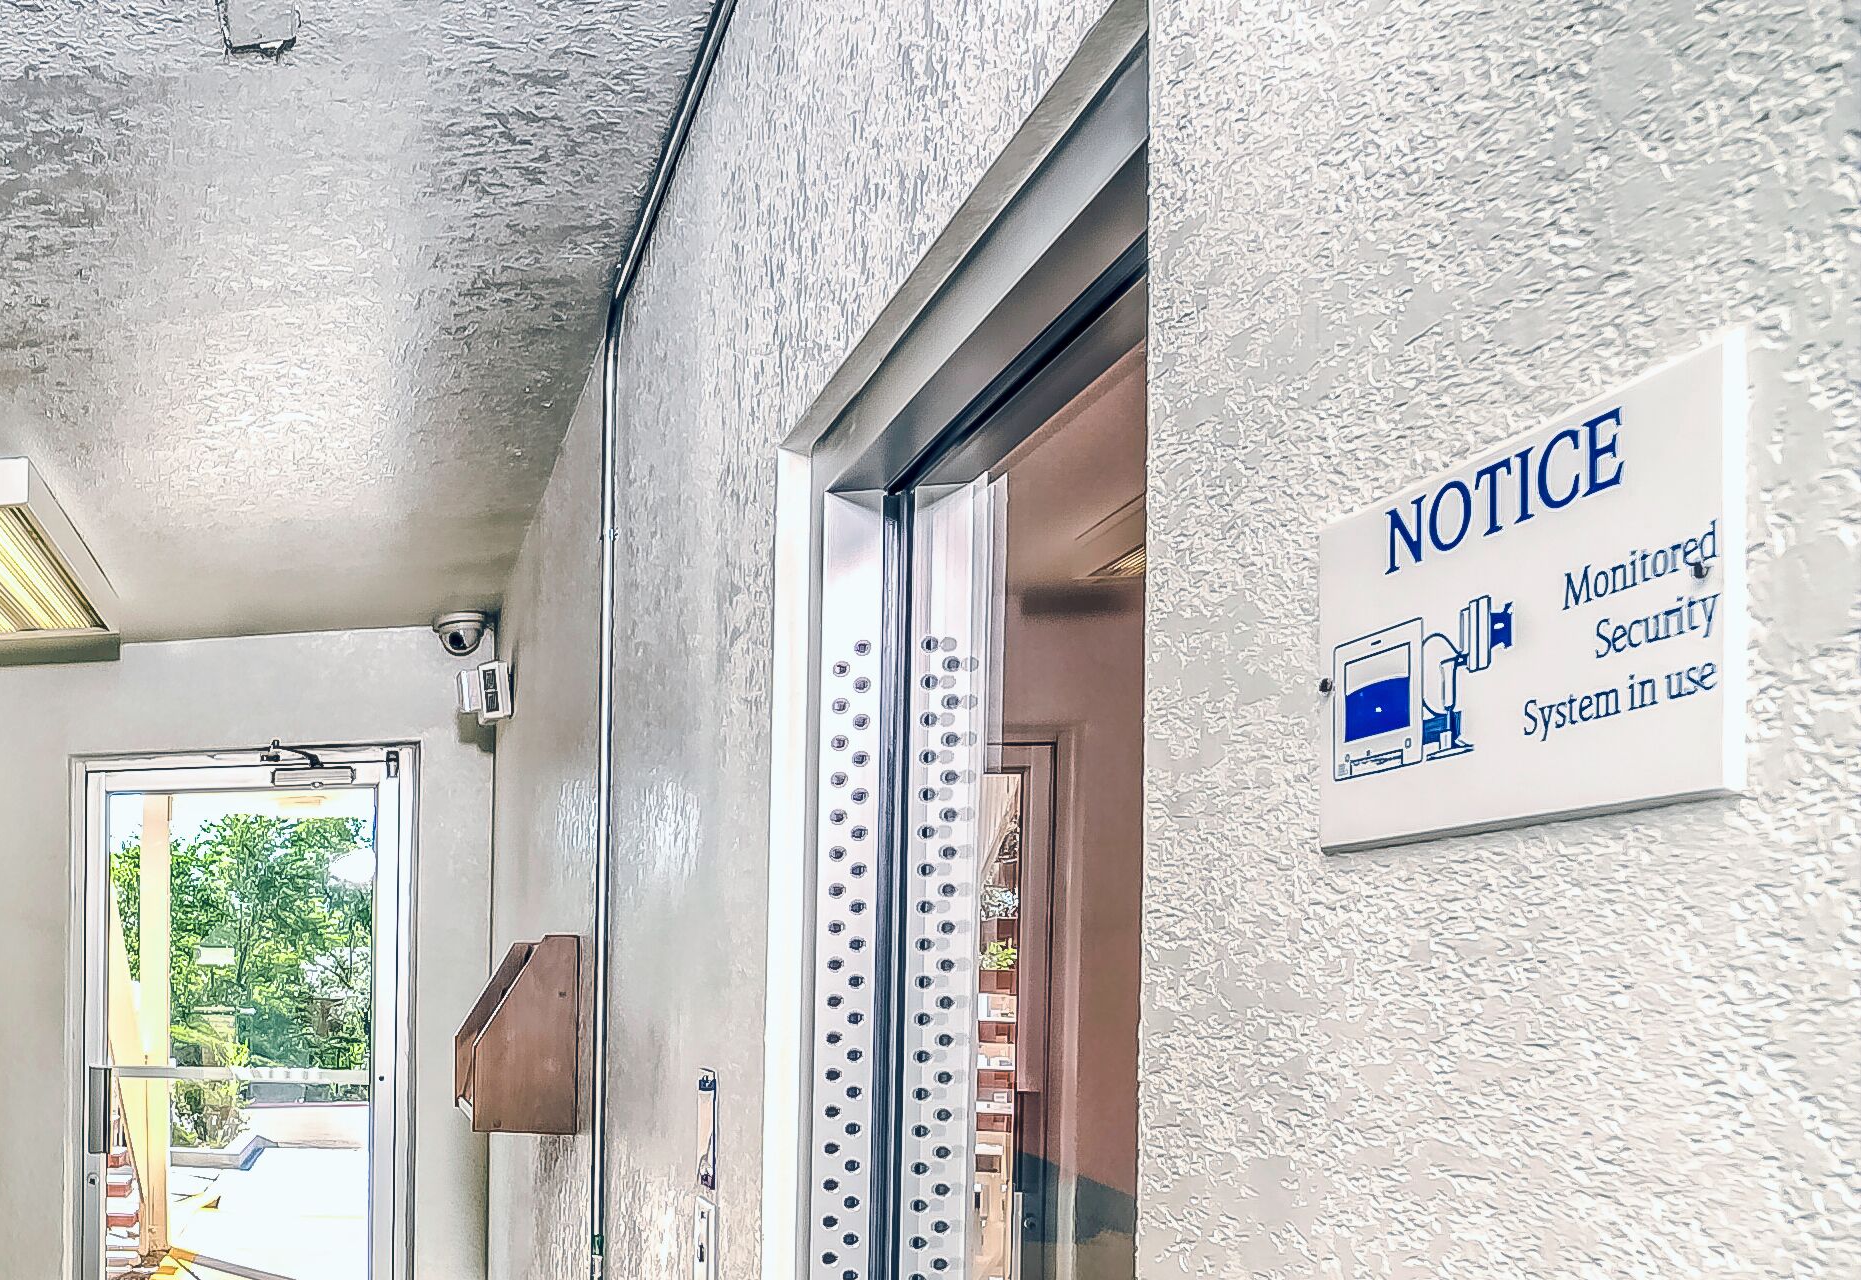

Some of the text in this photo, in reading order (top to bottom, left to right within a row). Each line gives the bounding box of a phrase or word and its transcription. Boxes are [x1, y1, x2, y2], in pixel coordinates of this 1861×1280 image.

[1385, 406, 1625, 575] NOTICE
[1562, 518, 1719, 611] Monitored
[1595, 592, 1721, 659] Security
[1523, 662, 1718, 742] System in use
